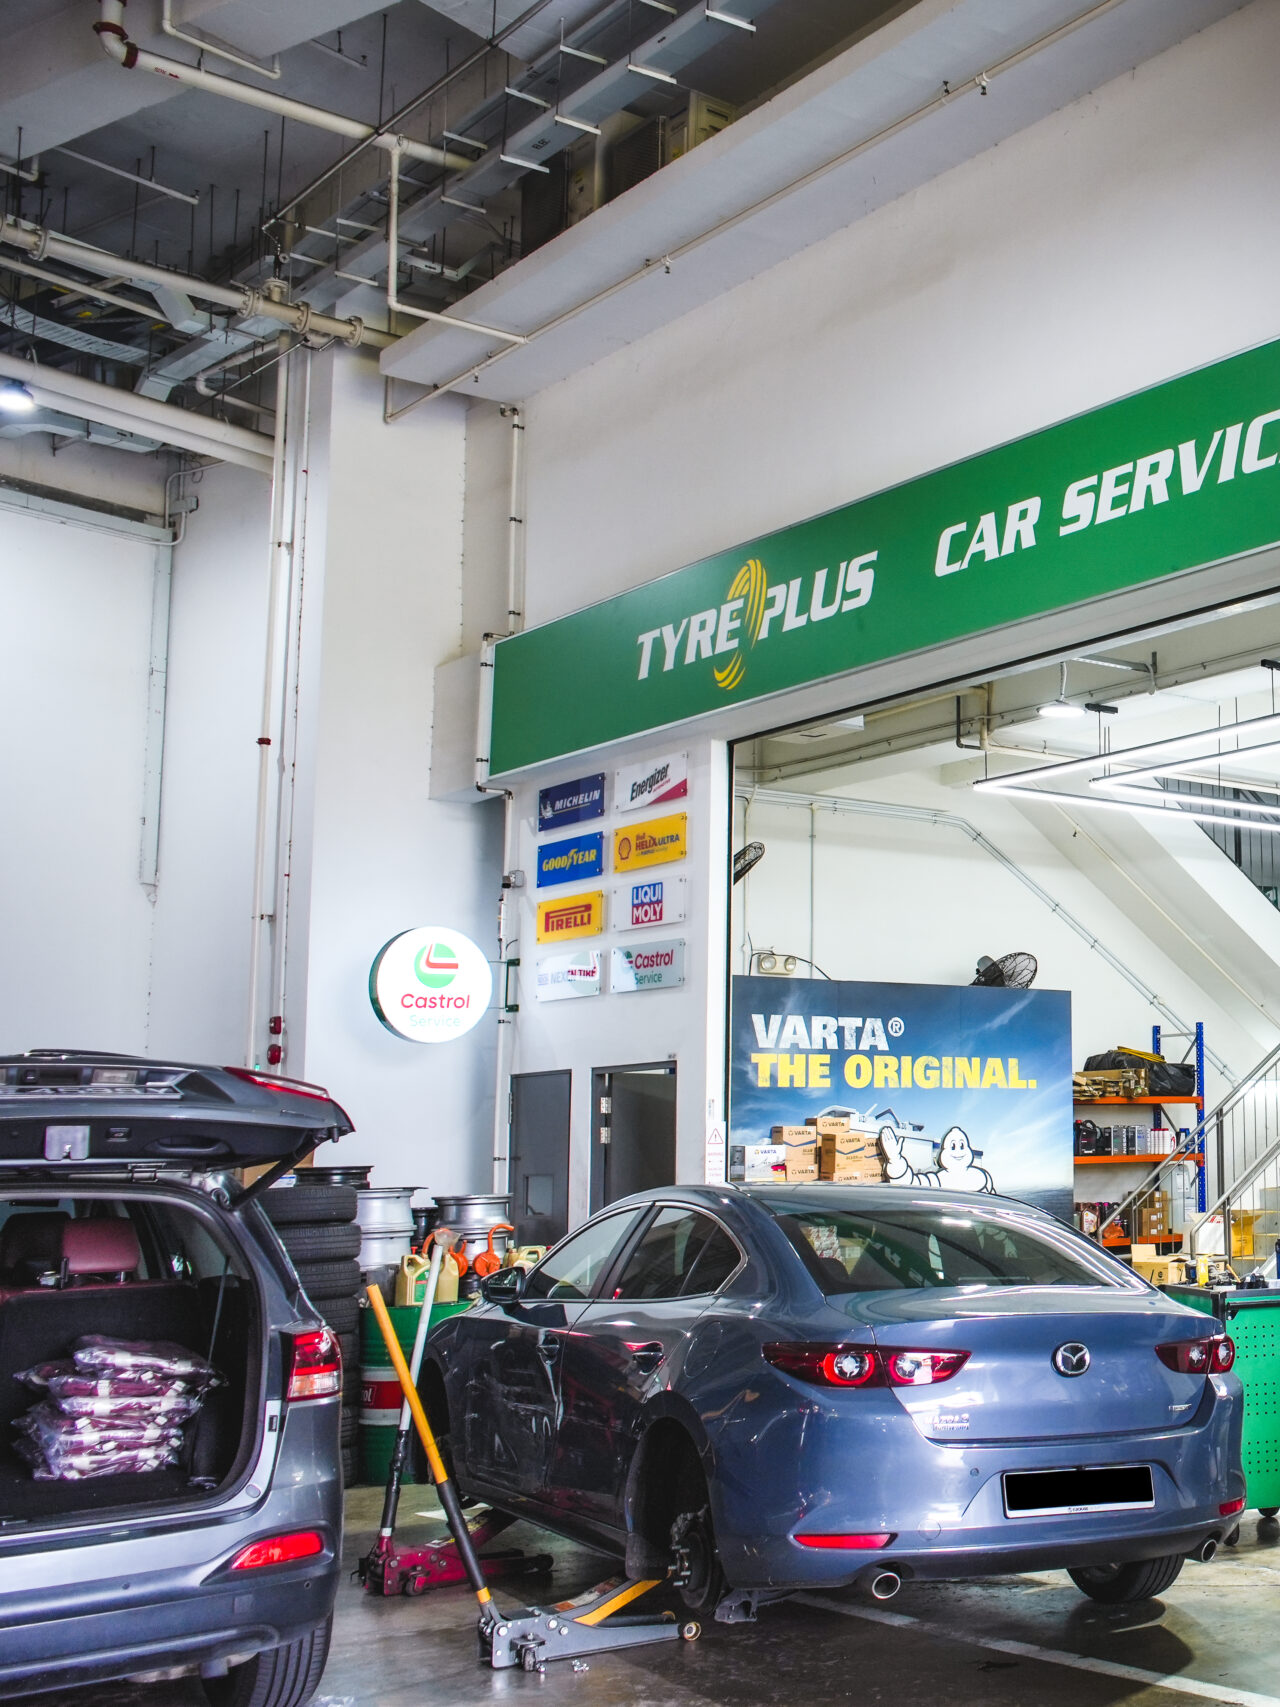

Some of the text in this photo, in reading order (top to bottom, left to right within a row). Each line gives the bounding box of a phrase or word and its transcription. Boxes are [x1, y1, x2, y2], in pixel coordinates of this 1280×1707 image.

[934, 495, 1043, 578] CAR
[630, 762, 670, 802] Energizer
[554, 789, 601, 811] MICHELIN
[657, 833, 680, 846] ULTRA
[542, 849, 597, 872] GOODYEAR
[632, 884, 663, 905] LIQUI
[544, 903, 592, 933] PIRELLI
[632, 903, 663, 924] MOLY
[634, 949, 674, 970] Castrol
[634, 971, 662, 985] Service
[401, 993, 470, 1009] Castrol
[409, 1014, 461, 1027] Service
[751, 1053, 1038, 1089] THE ORIGINAL.
